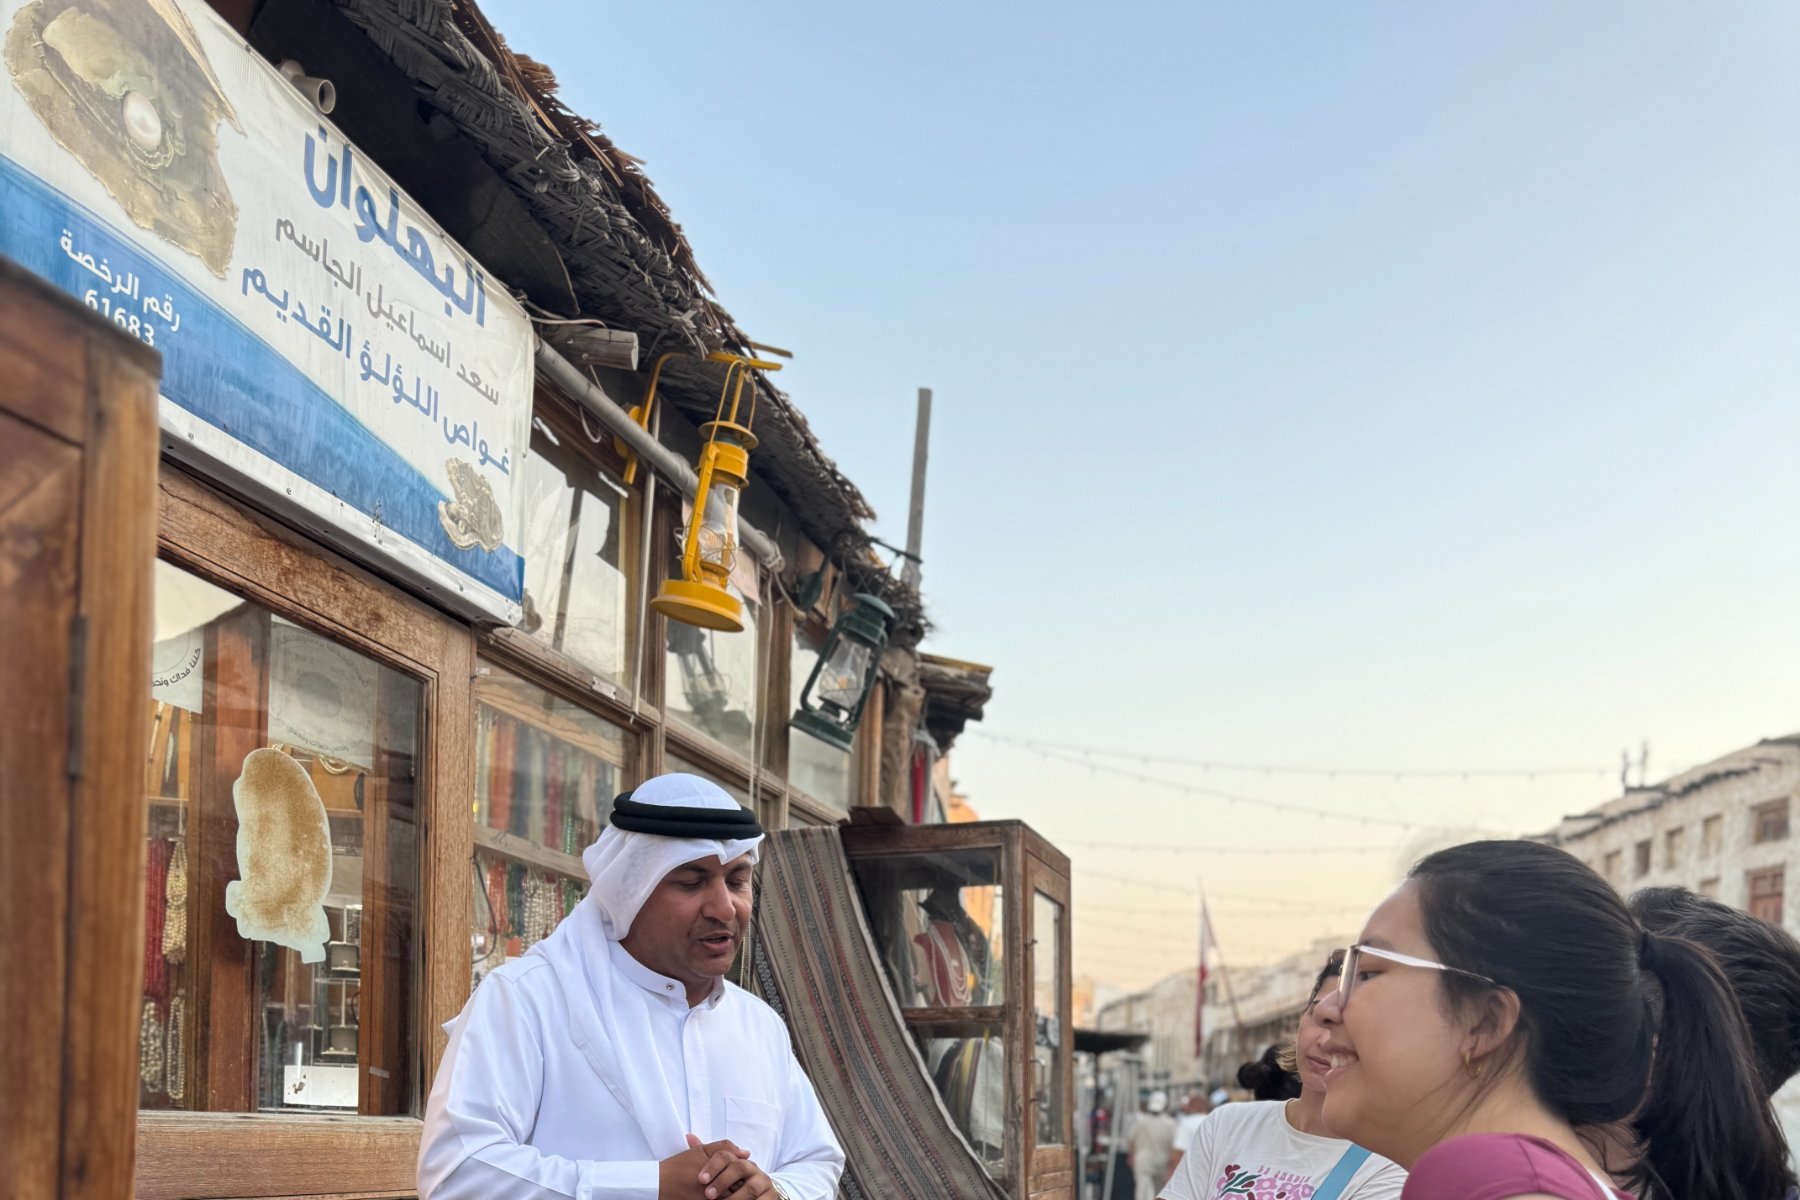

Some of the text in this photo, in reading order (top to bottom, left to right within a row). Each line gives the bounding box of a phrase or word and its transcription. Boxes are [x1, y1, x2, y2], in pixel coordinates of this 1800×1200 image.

[60, 228, 180, 332] رقم الرخصة
[85, 289, 154, 347] 61683
[276, 218, 499, 405] سعد اسماعيل الجاسم
[304, 124, 486, 328] البهلوان
[242, 268, 510, 476] غواص اللؤلؤ القديم
